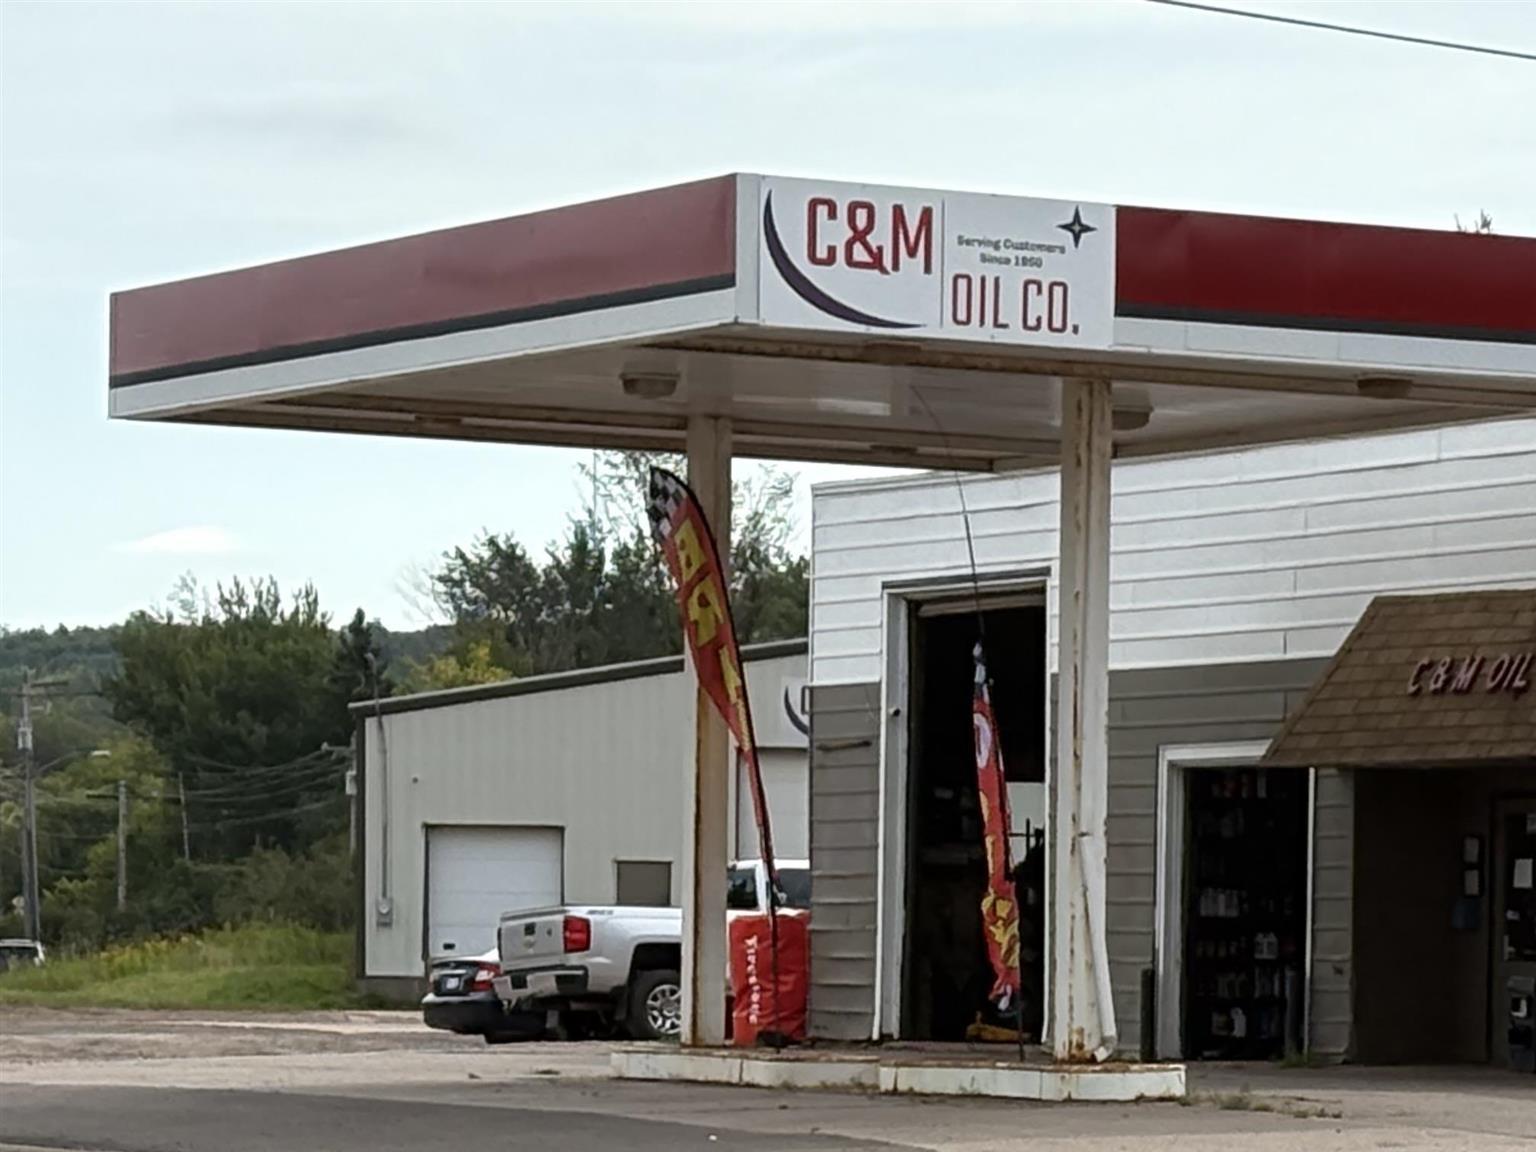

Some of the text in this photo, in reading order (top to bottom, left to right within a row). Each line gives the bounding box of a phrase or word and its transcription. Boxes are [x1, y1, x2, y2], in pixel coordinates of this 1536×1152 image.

[806, 197, 934, 275] C&M
[957, 234, 1066, 254] Serving Customers
[979, 252, 1011, 266] Since
[952, 273, 1080, 335] OIL CO.
[1486, 652, 1534, 690] OIL
